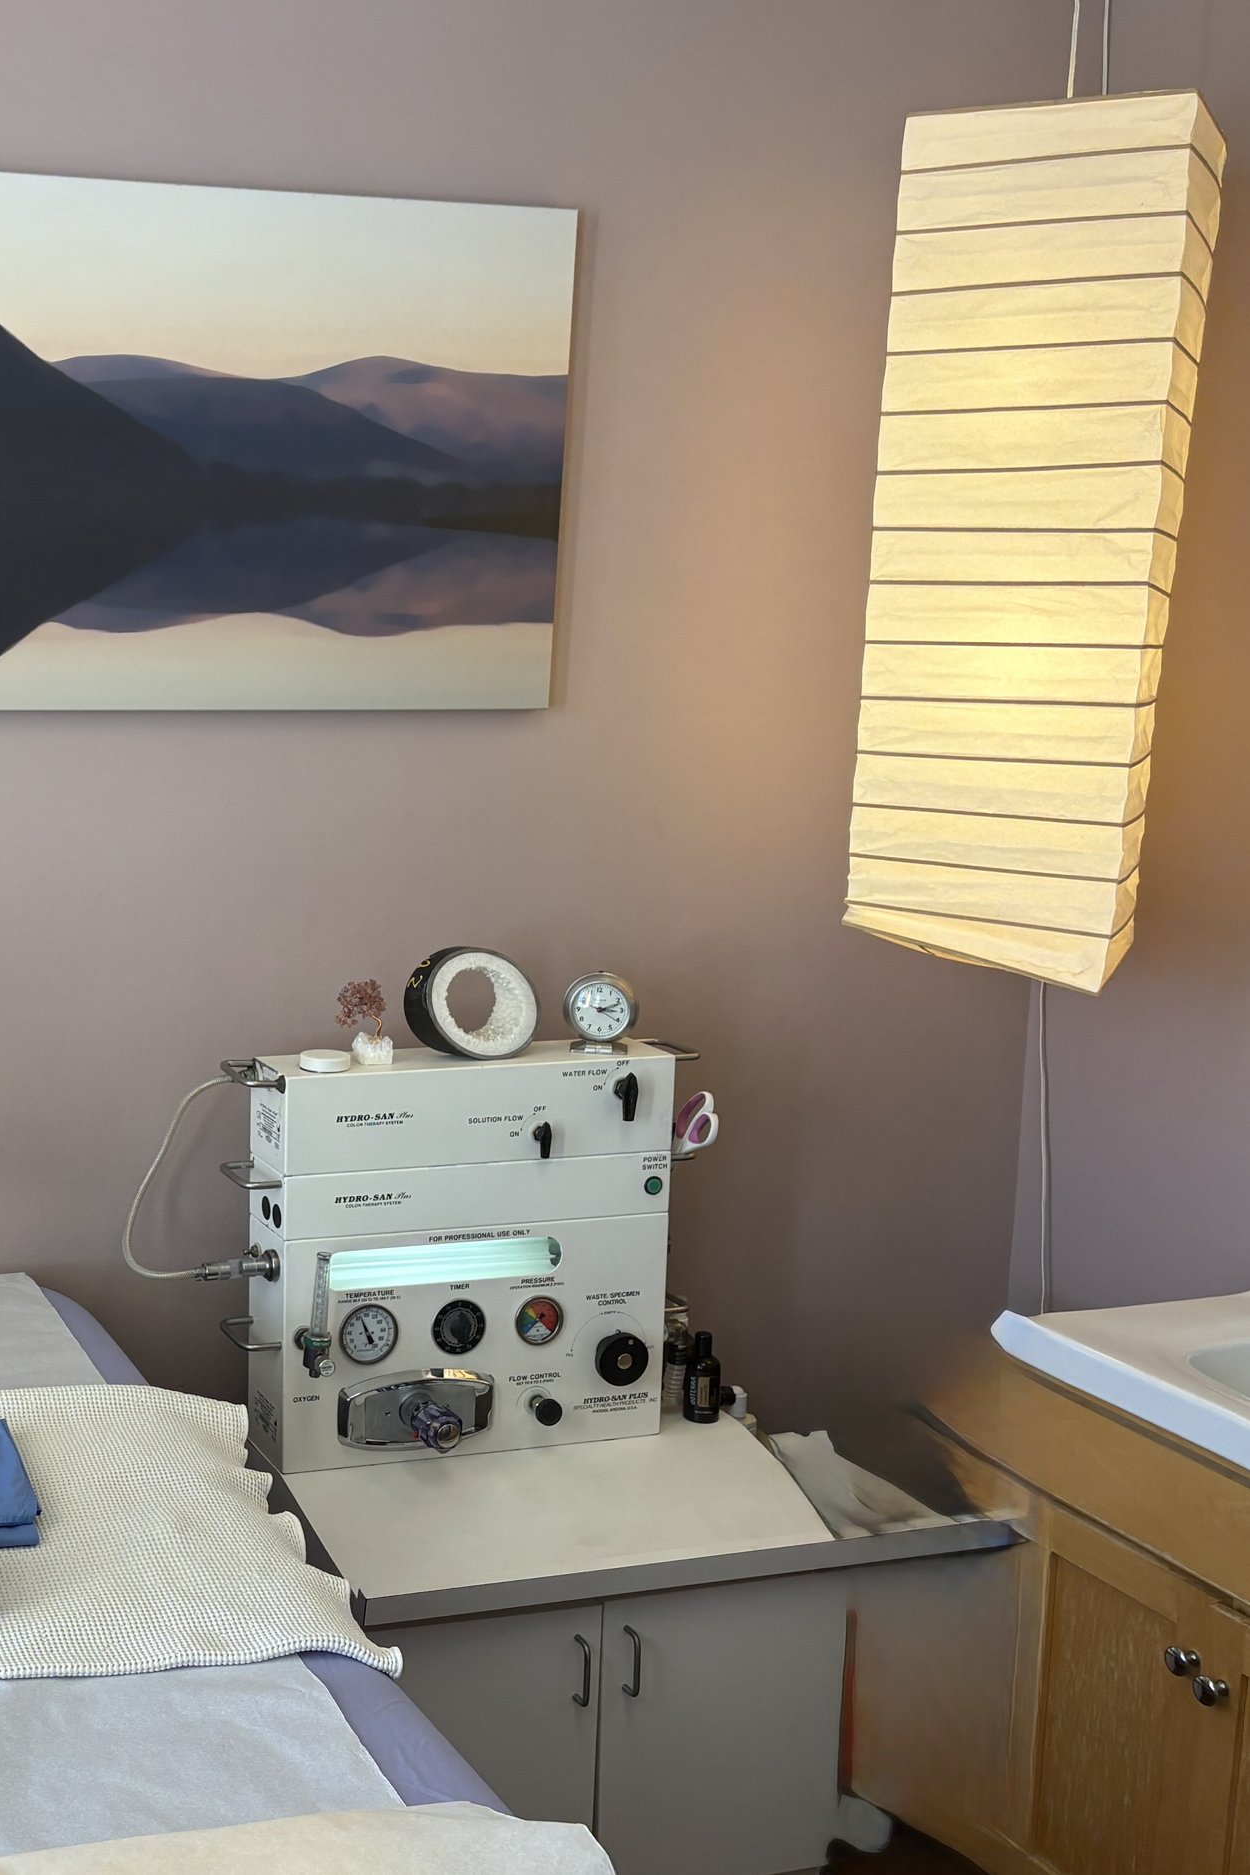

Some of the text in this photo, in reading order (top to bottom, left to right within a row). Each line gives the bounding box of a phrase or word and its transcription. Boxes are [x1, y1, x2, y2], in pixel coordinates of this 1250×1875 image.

[562, 1069, 586, 1077] WATER
[336, 1112, 395, 1123] HYDRO-SAN
[468, 1116, 502, 1124] SOLUTION
[334, 1193, 393, 1204] HYDRO-SAN
[444, 1231, 495, 1241] PROFESSIONAL
[521, 1276, 555, 1285] PRESSURE
[345, 1289, 395, 1299] TEMPERATURE
[597, 1298, 627, 1306] CONTROL
[530, 1371, 561, 1380] CONTROL
[293, 1395, 320, 1403] OXYGEN
[628, 1392, 649, 1400] PLUS
